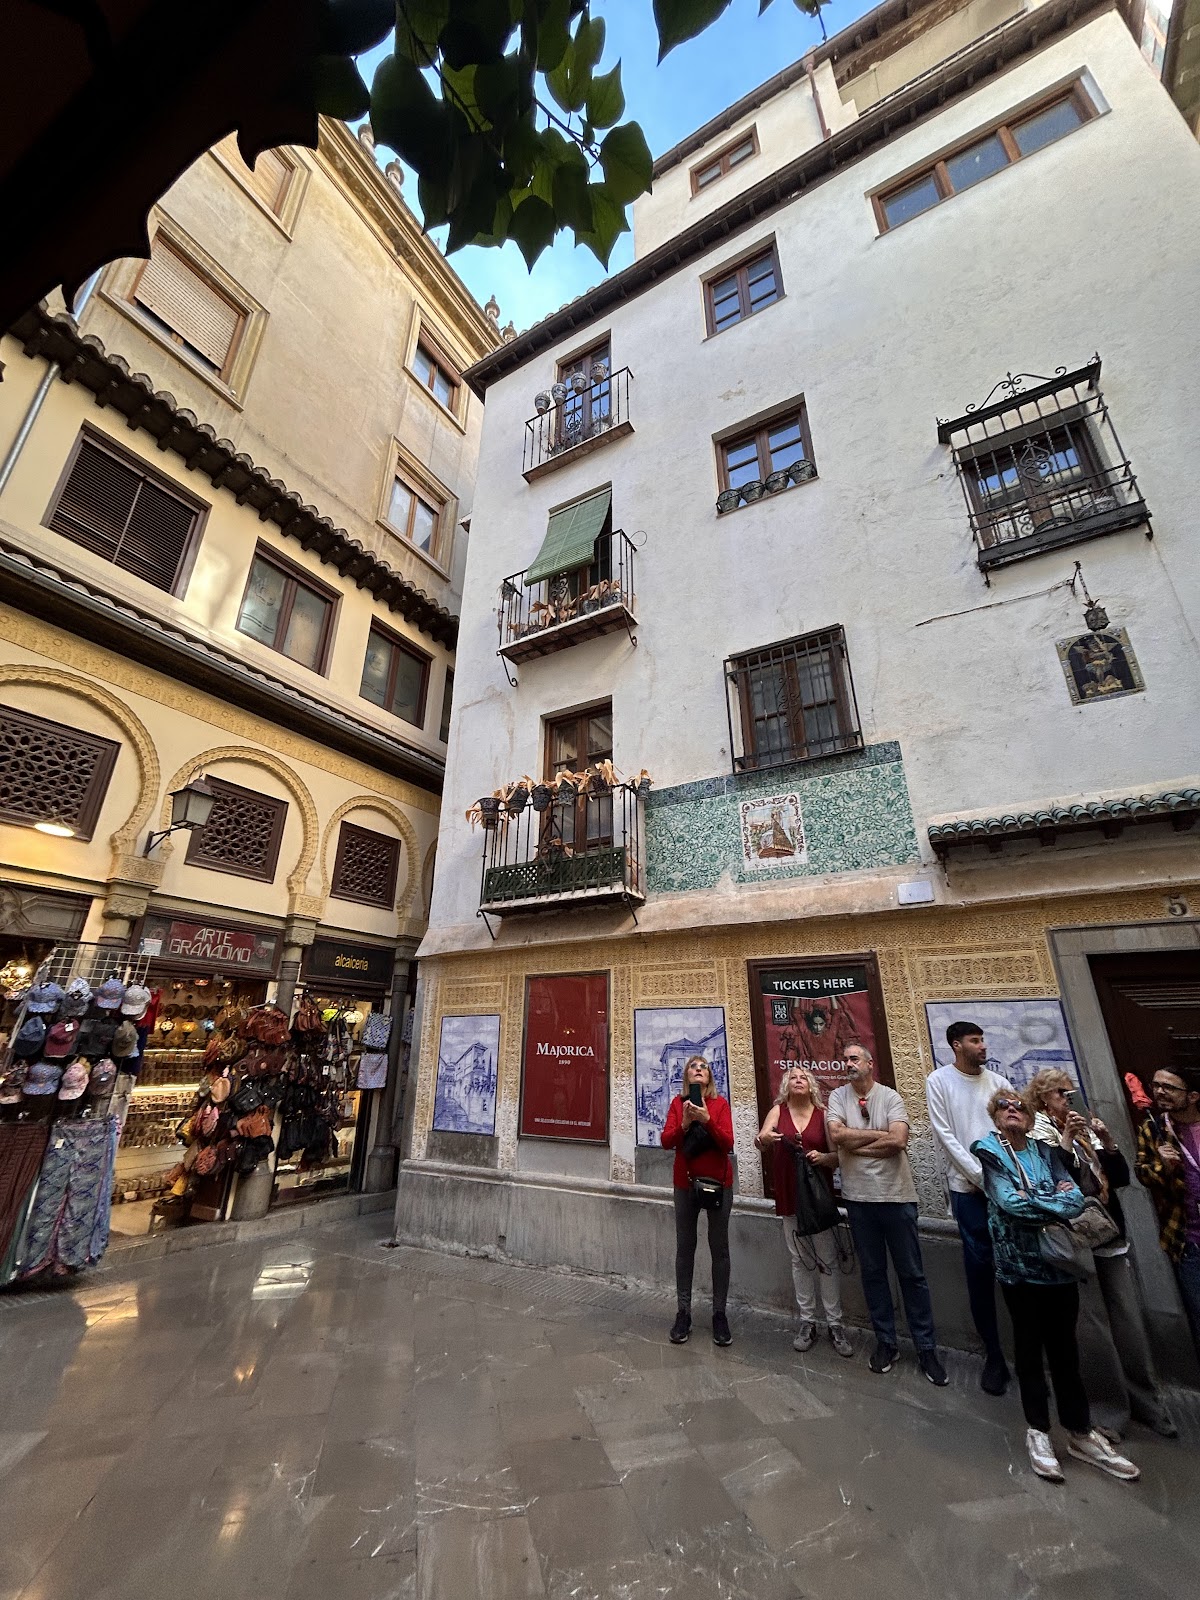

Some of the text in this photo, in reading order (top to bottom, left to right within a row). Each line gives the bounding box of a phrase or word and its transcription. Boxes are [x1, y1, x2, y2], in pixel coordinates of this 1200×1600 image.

[1169, 893, 1187, 917] 5
[194, 927, 235, 946] ARTE
[169, 938, 251, 963] GRANADINO
[773, 978, 855, 991] TICKETS HERE
